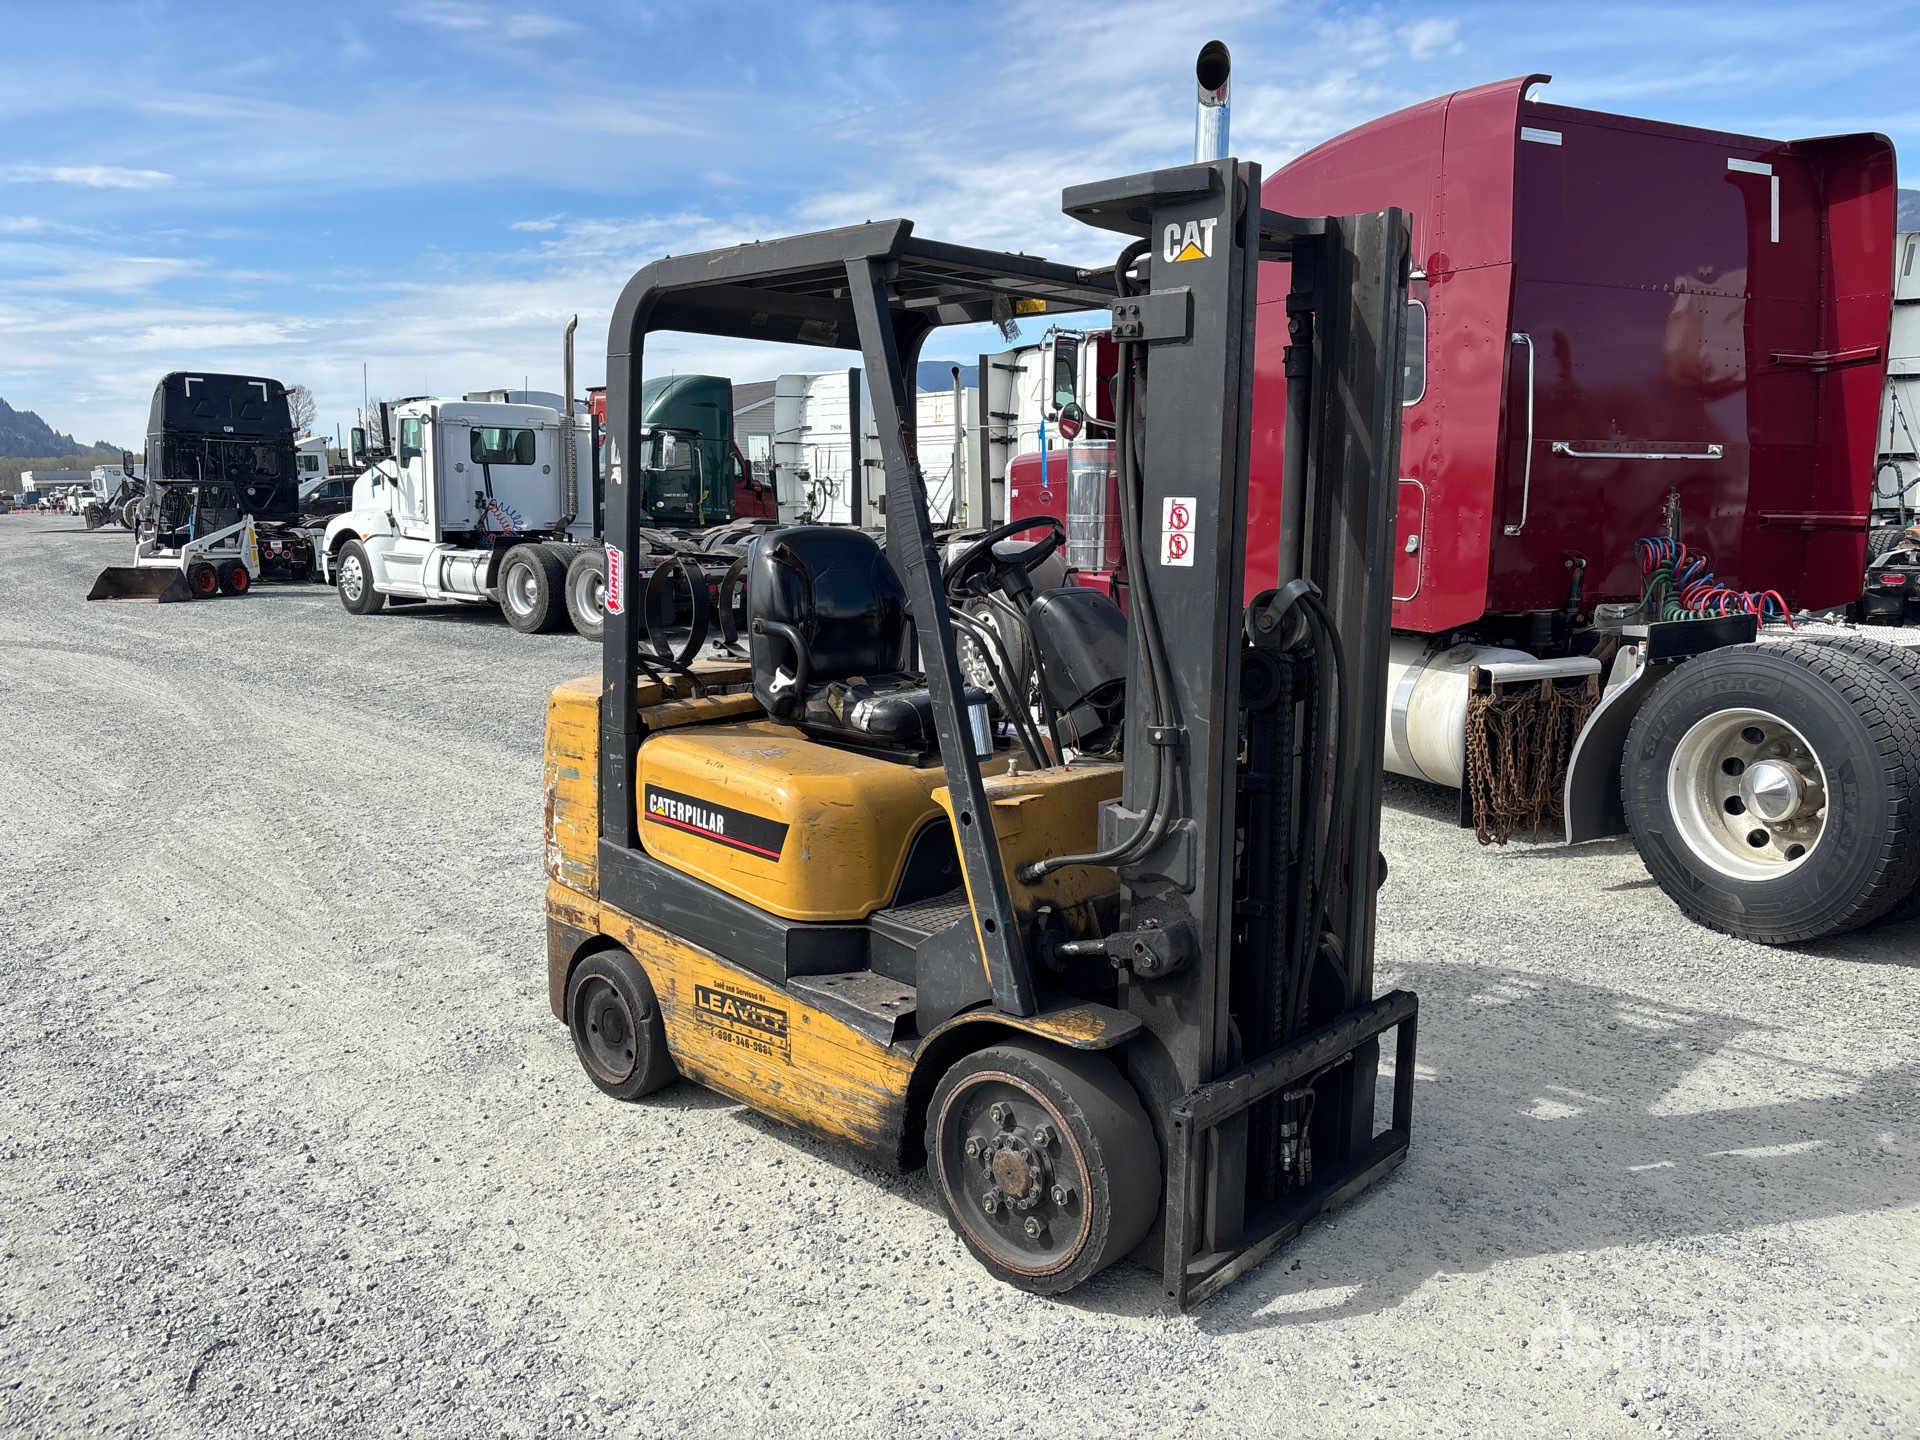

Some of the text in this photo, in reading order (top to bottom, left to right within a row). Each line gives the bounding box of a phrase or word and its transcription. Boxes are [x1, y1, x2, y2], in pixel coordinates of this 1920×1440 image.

[1163, 217, 1218, 263] CAT
[608, 550, 620, 610] SUMMIT
[650, 794, 724, 835] CATERPILLAR
[698, 990, 784, 1032] LEAVITT
[714, 980, 766, 1003] Sold and Serviced By
